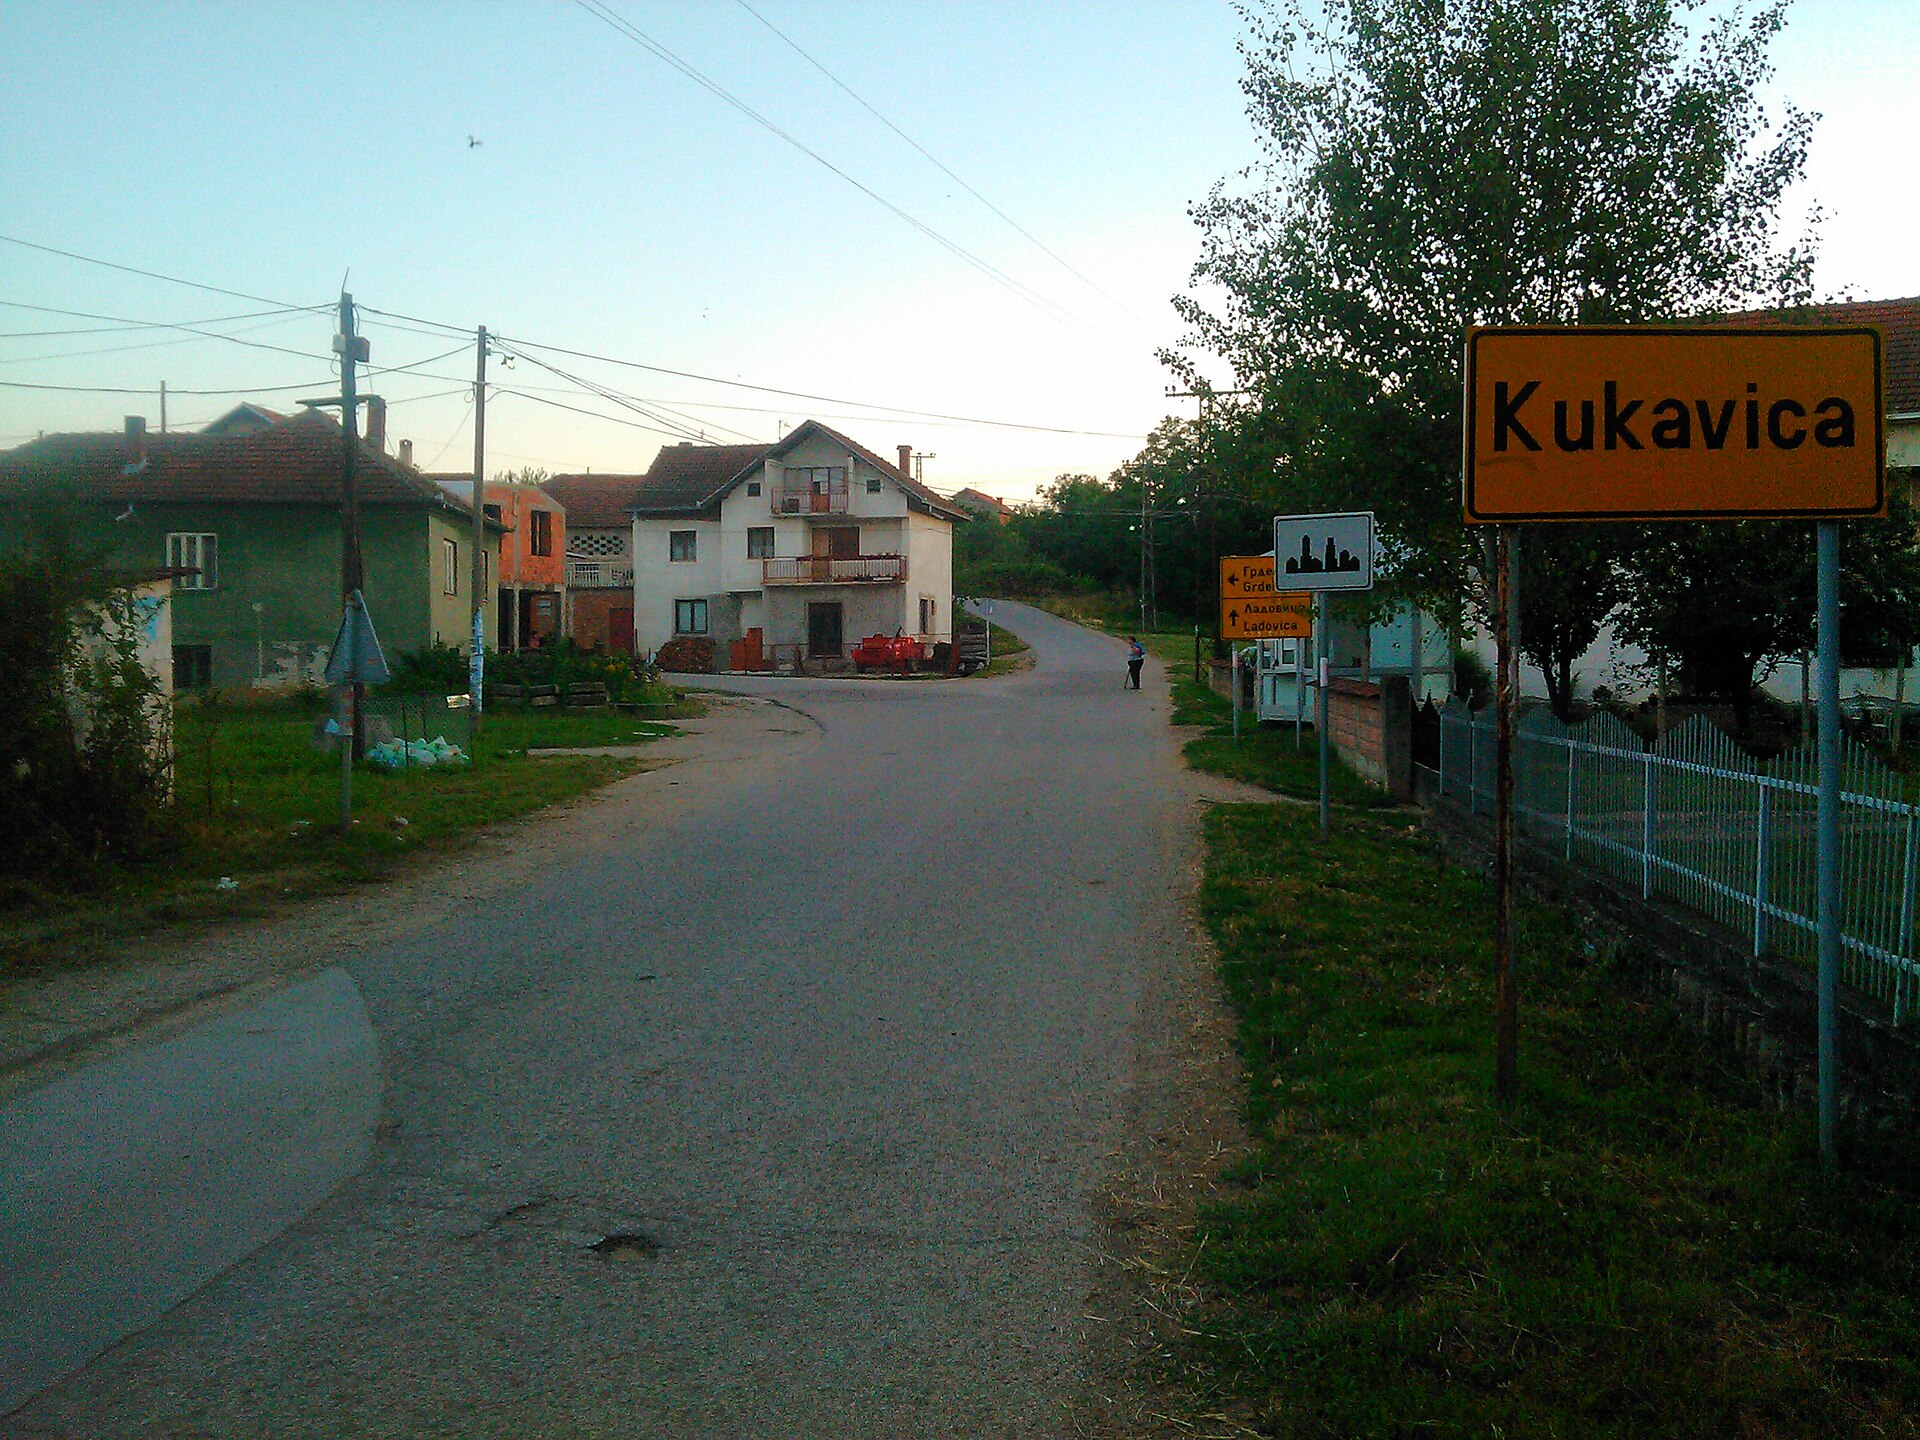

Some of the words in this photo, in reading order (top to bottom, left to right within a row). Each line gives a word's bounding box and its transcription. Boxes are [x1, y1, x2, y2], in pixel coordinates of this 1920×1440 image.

[1493, 380, 1855, 452] Kukavica
[1243, 566, 1275, 580] Грде
[1244, 621, 1298, 632] Ladovica
